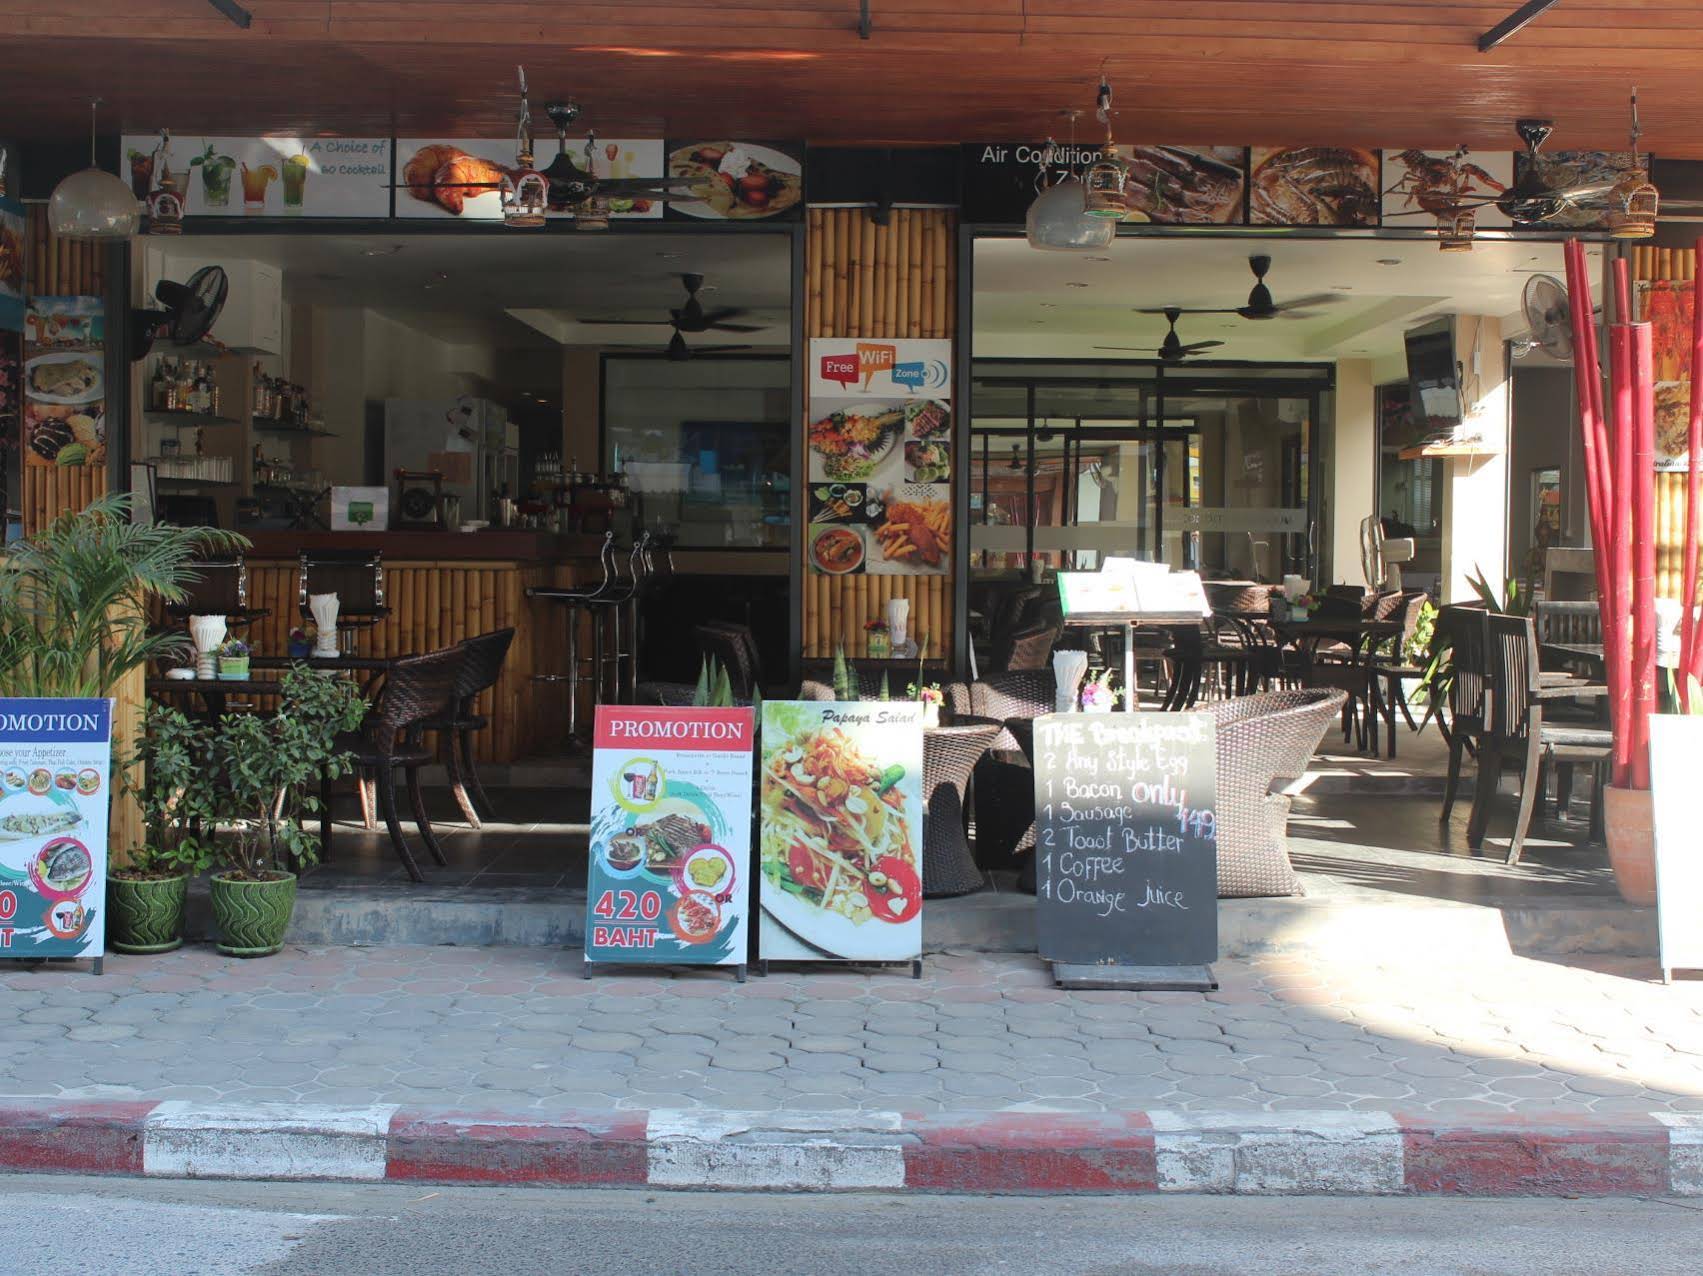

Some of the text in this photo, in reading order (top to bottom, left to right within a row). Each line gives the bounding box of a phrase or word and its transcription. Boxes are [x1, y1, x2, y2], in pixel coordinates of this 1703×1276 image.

[309, 141, 385, 156] A Choice of
[981, 146, 1103, 165] Air Codition
[339, 164, 386, 176] Cocktail
[826, 361, 854, 373] Free
[859, 350, 893, 365] WiFi
[895, 368, 920, 378] Zone
[822, 709, 915, 726] Papaya Salad
[609, 720, 744, 740] PROMOTION
[15, 750, 31, 759] your
[33, 745, 66, 760] Appetizer
[1043, 742, 1189, 780] 2 Any Style Egg
[1045, 776, 1123, 801] 1 Bacon
[1043, 801, 1133, 826] 1 Sausage
[1042, 825, 1184, 853] 2 Toast Butter
[1042, 853, 1052, 873] 1
[594, 889, 662, 920] 420
[715, 893, 733, 904] OR
[1041, 879, 1051, 899] 1
[1057, 877, 1127, 917] Orange
[593, 927, 658, 948] BAHT
